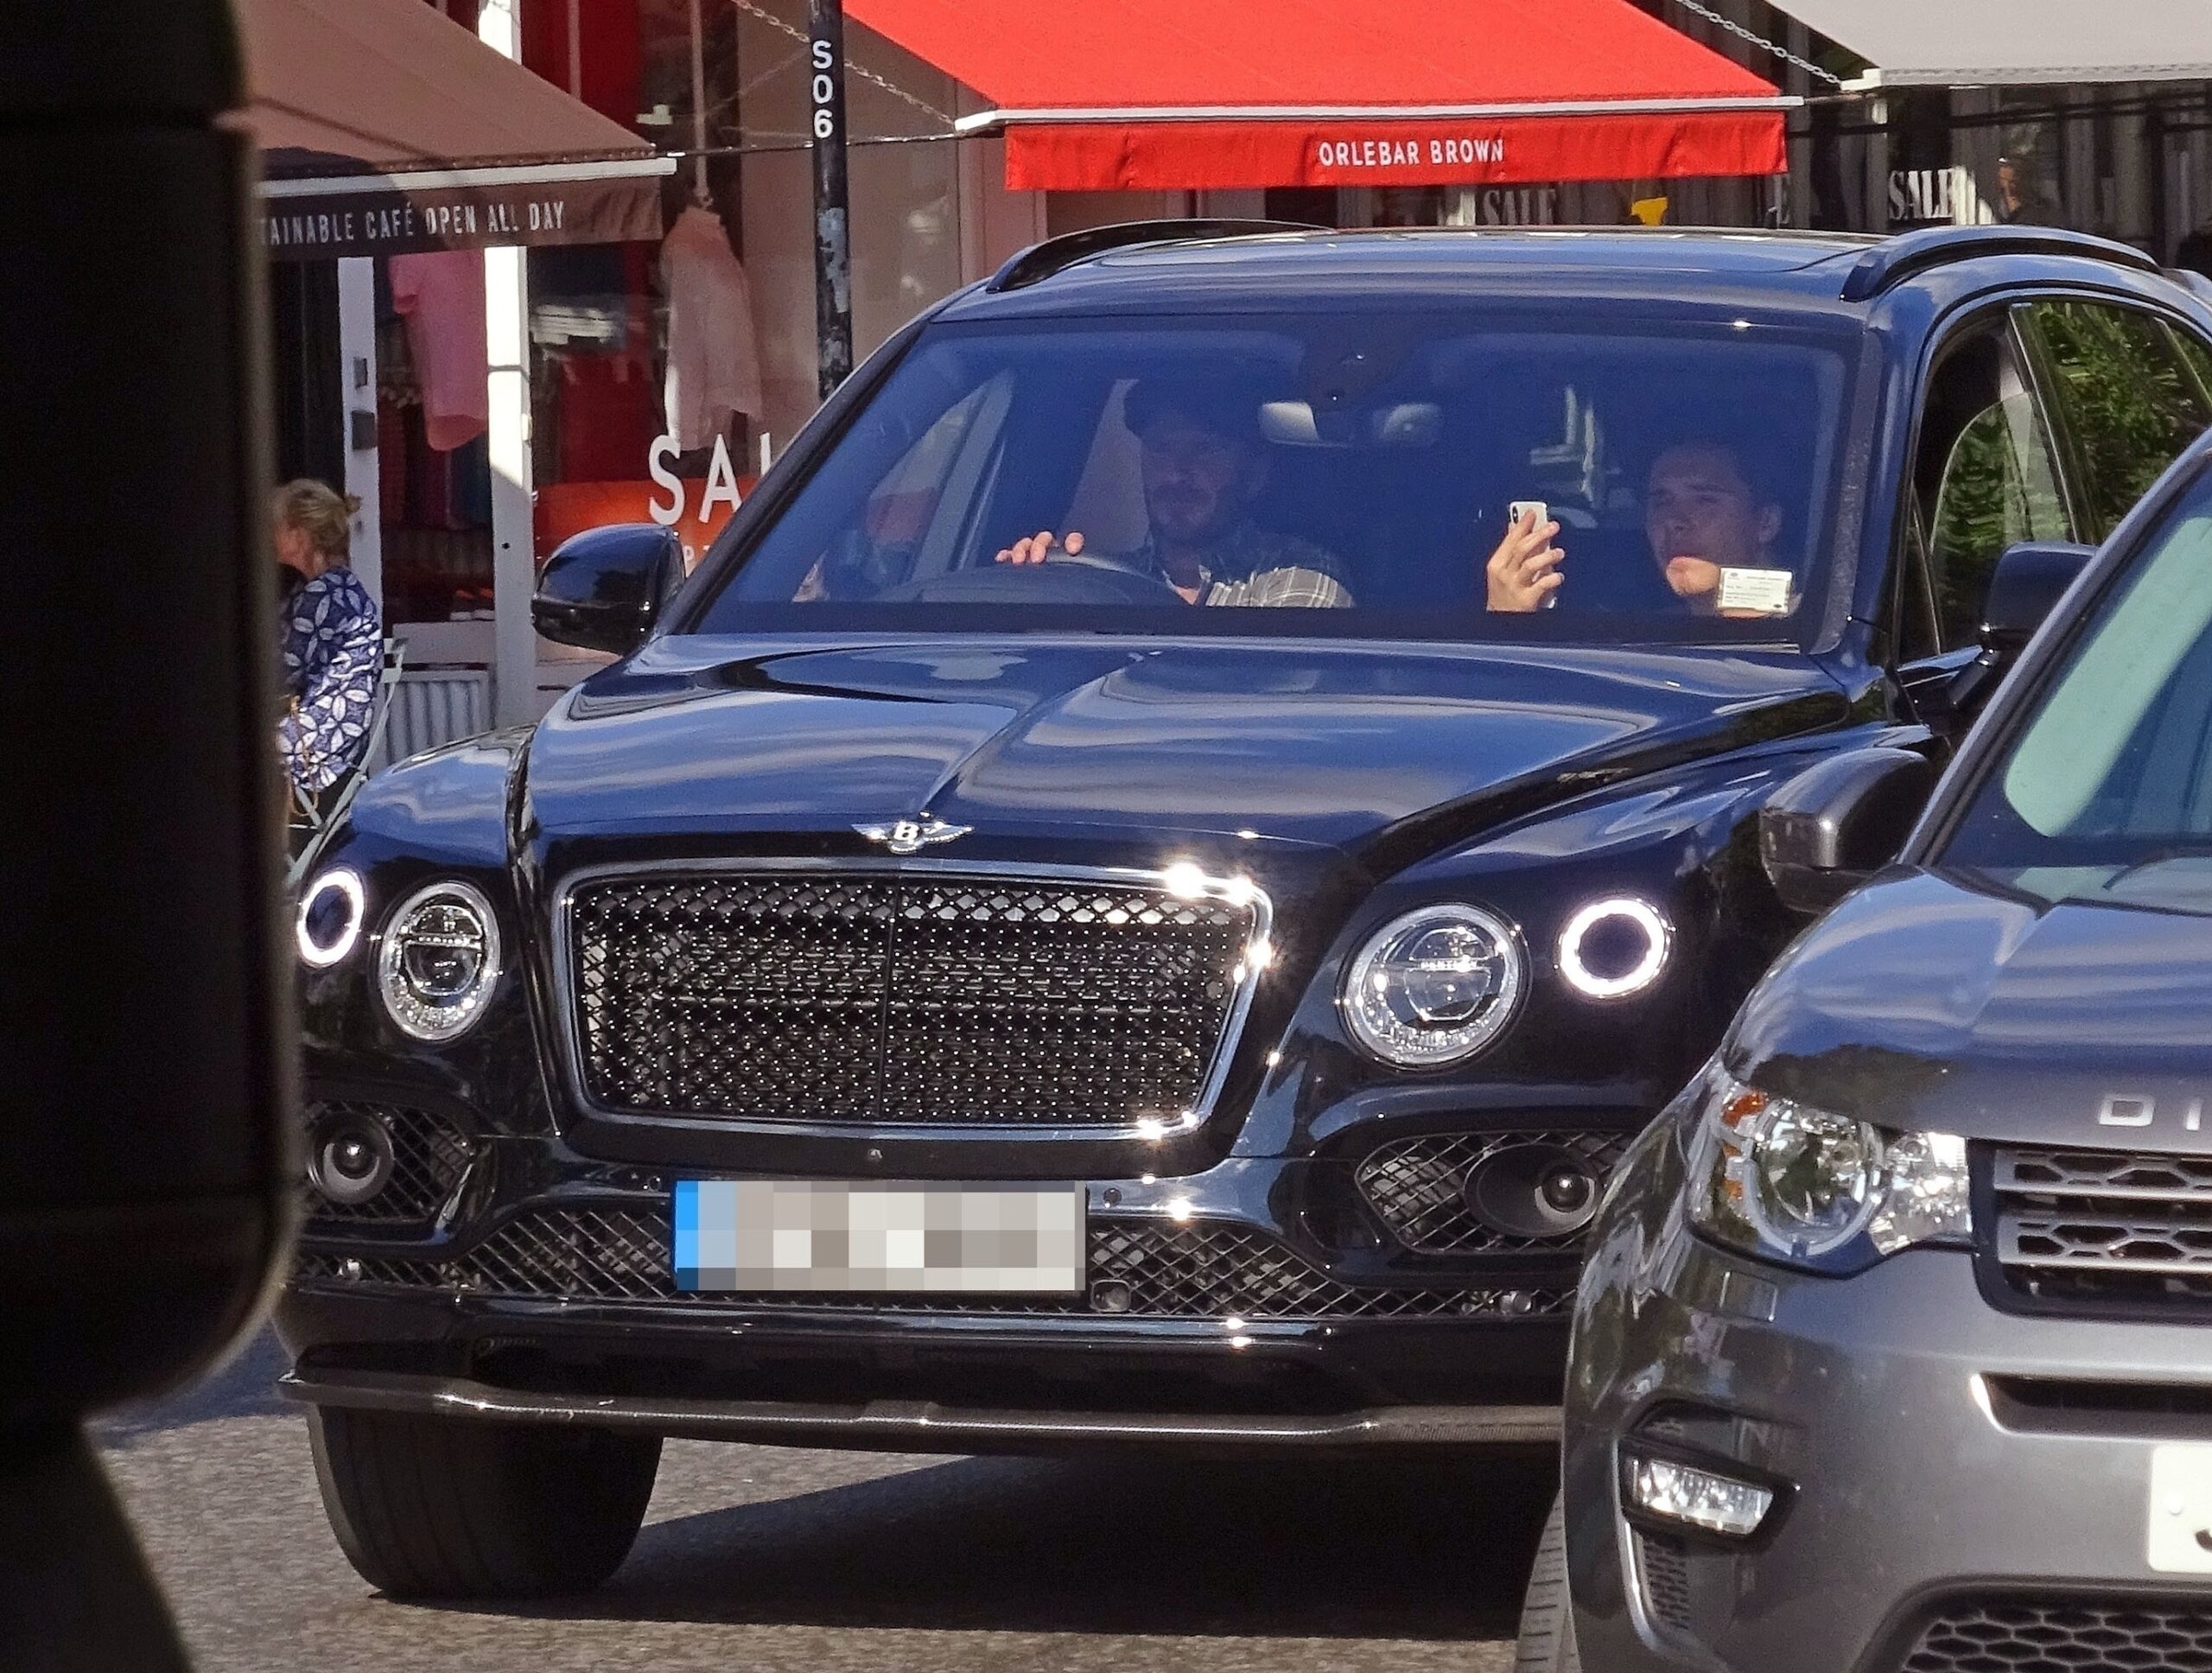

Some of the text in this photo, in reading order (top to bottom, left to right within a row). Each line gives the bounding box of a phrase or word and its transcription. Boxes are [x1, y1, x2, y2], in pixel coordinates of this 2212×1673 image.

[1319, 139, 1503, 167] ORLEBAR BROWN
[365, 200, 414, 239] CAFÉ
[425, 205, 476, 234] OPEN
[488, 203, 519, 233] ALL
[529, 200, 564, 231] DAY
